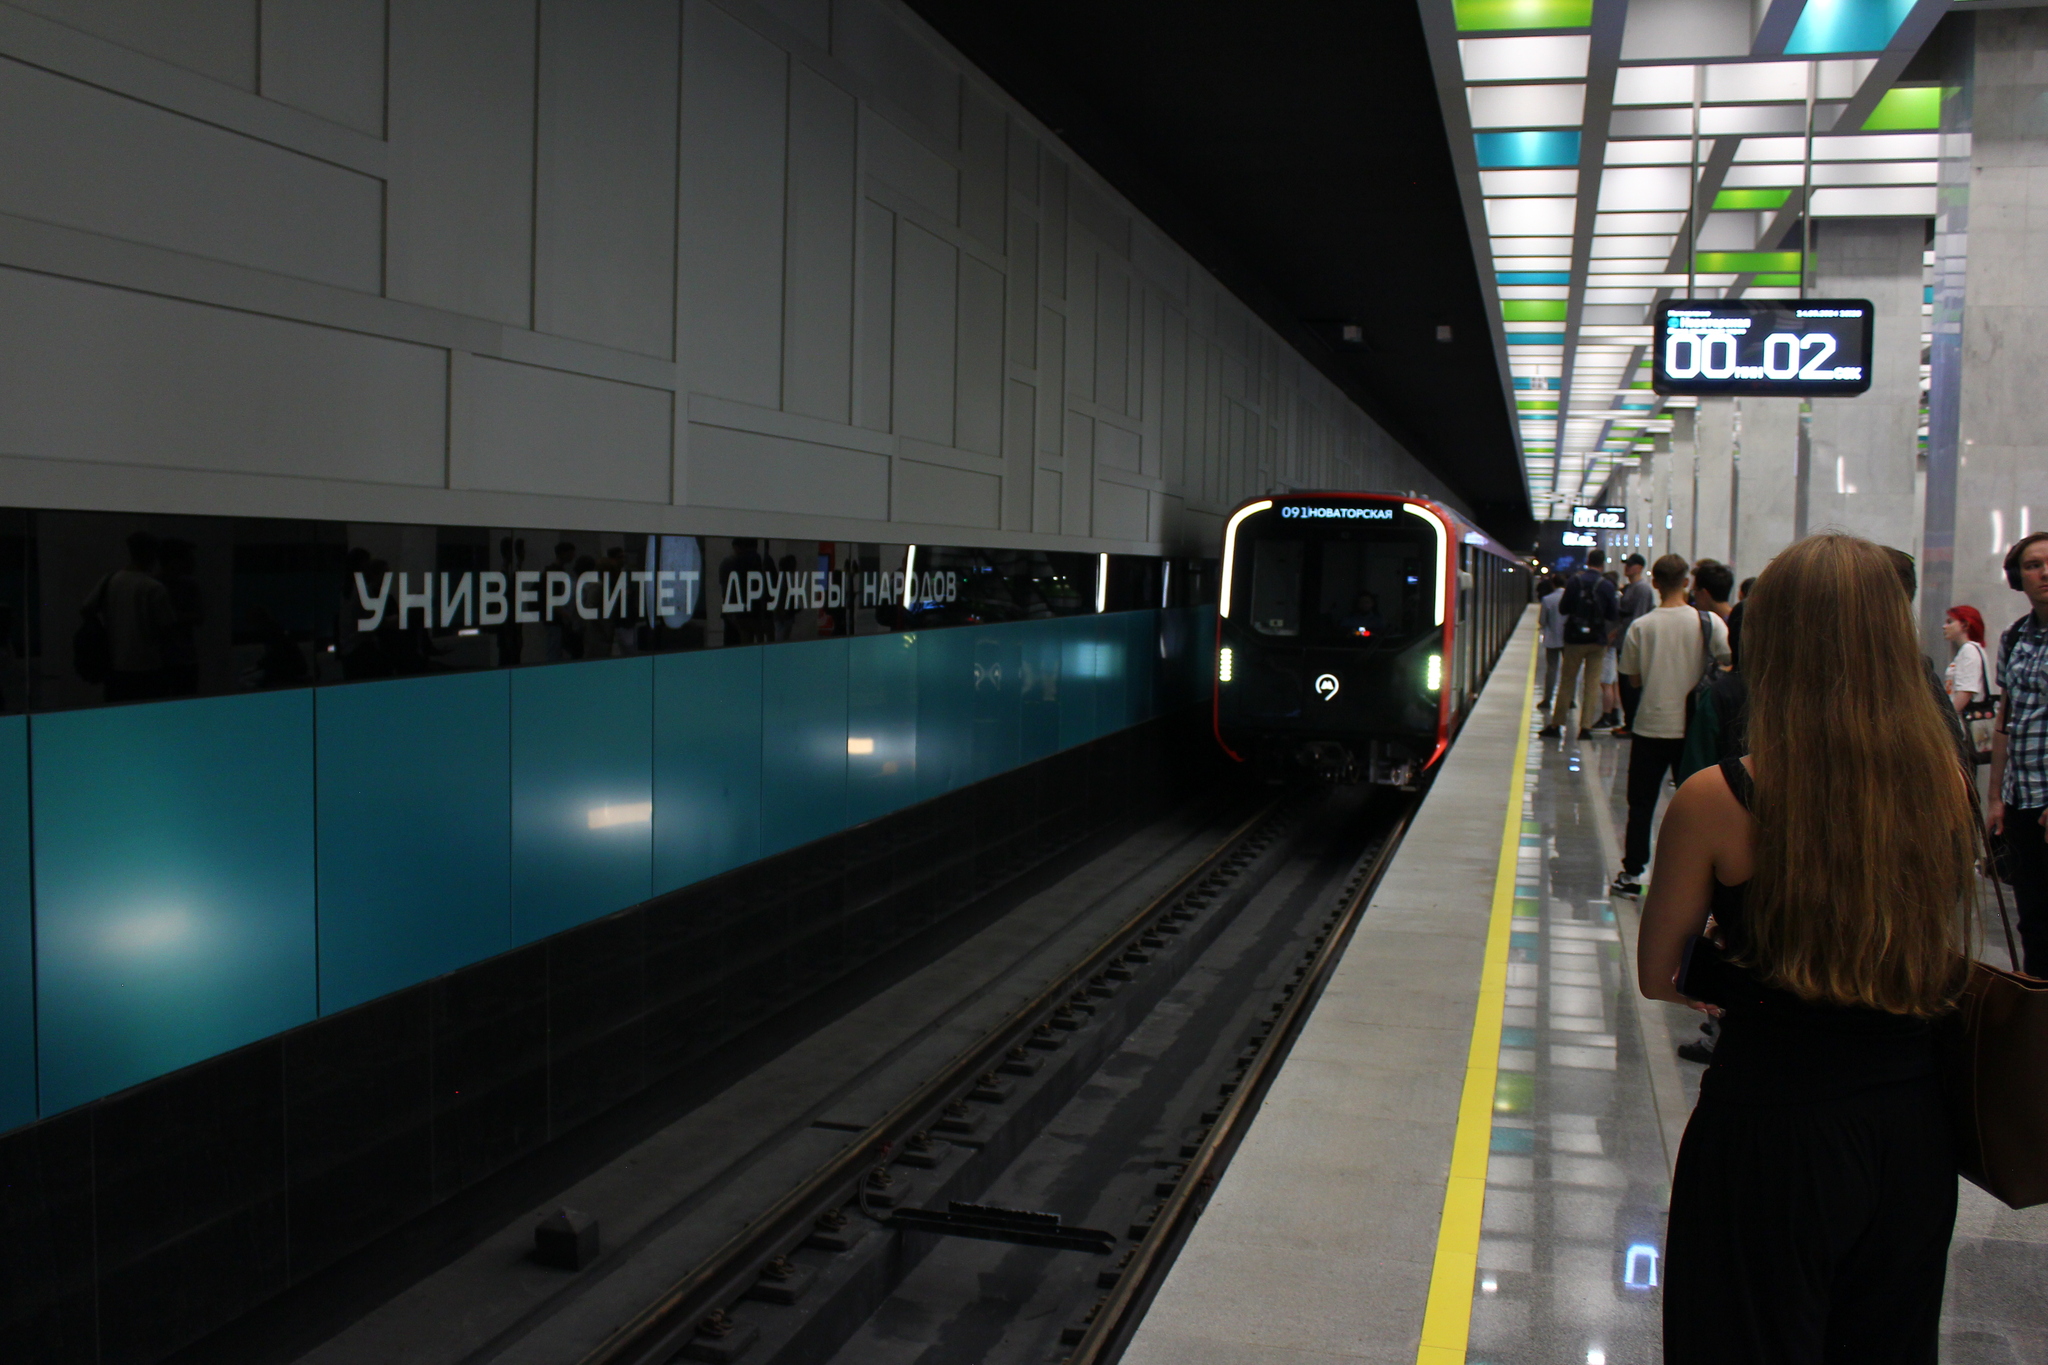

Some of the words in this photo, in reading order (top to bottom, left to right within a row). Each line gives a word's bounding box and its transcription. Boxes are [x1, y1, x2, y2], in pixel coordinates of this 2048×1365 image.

[1666, 333, 1737, 379] 00
[1764, 333, 1837, 380] 02
[1282, 507, 1308, 519] 091
[1308, 507, 1393, 519] НОВАТОРСКАЯ
[353, 570, 699, 632] УНИВЕРСИТЕТ
[721, 571, 845, 613] ДРУЖБЫ
[863, 571, 957, 606] НАРОДОВ
